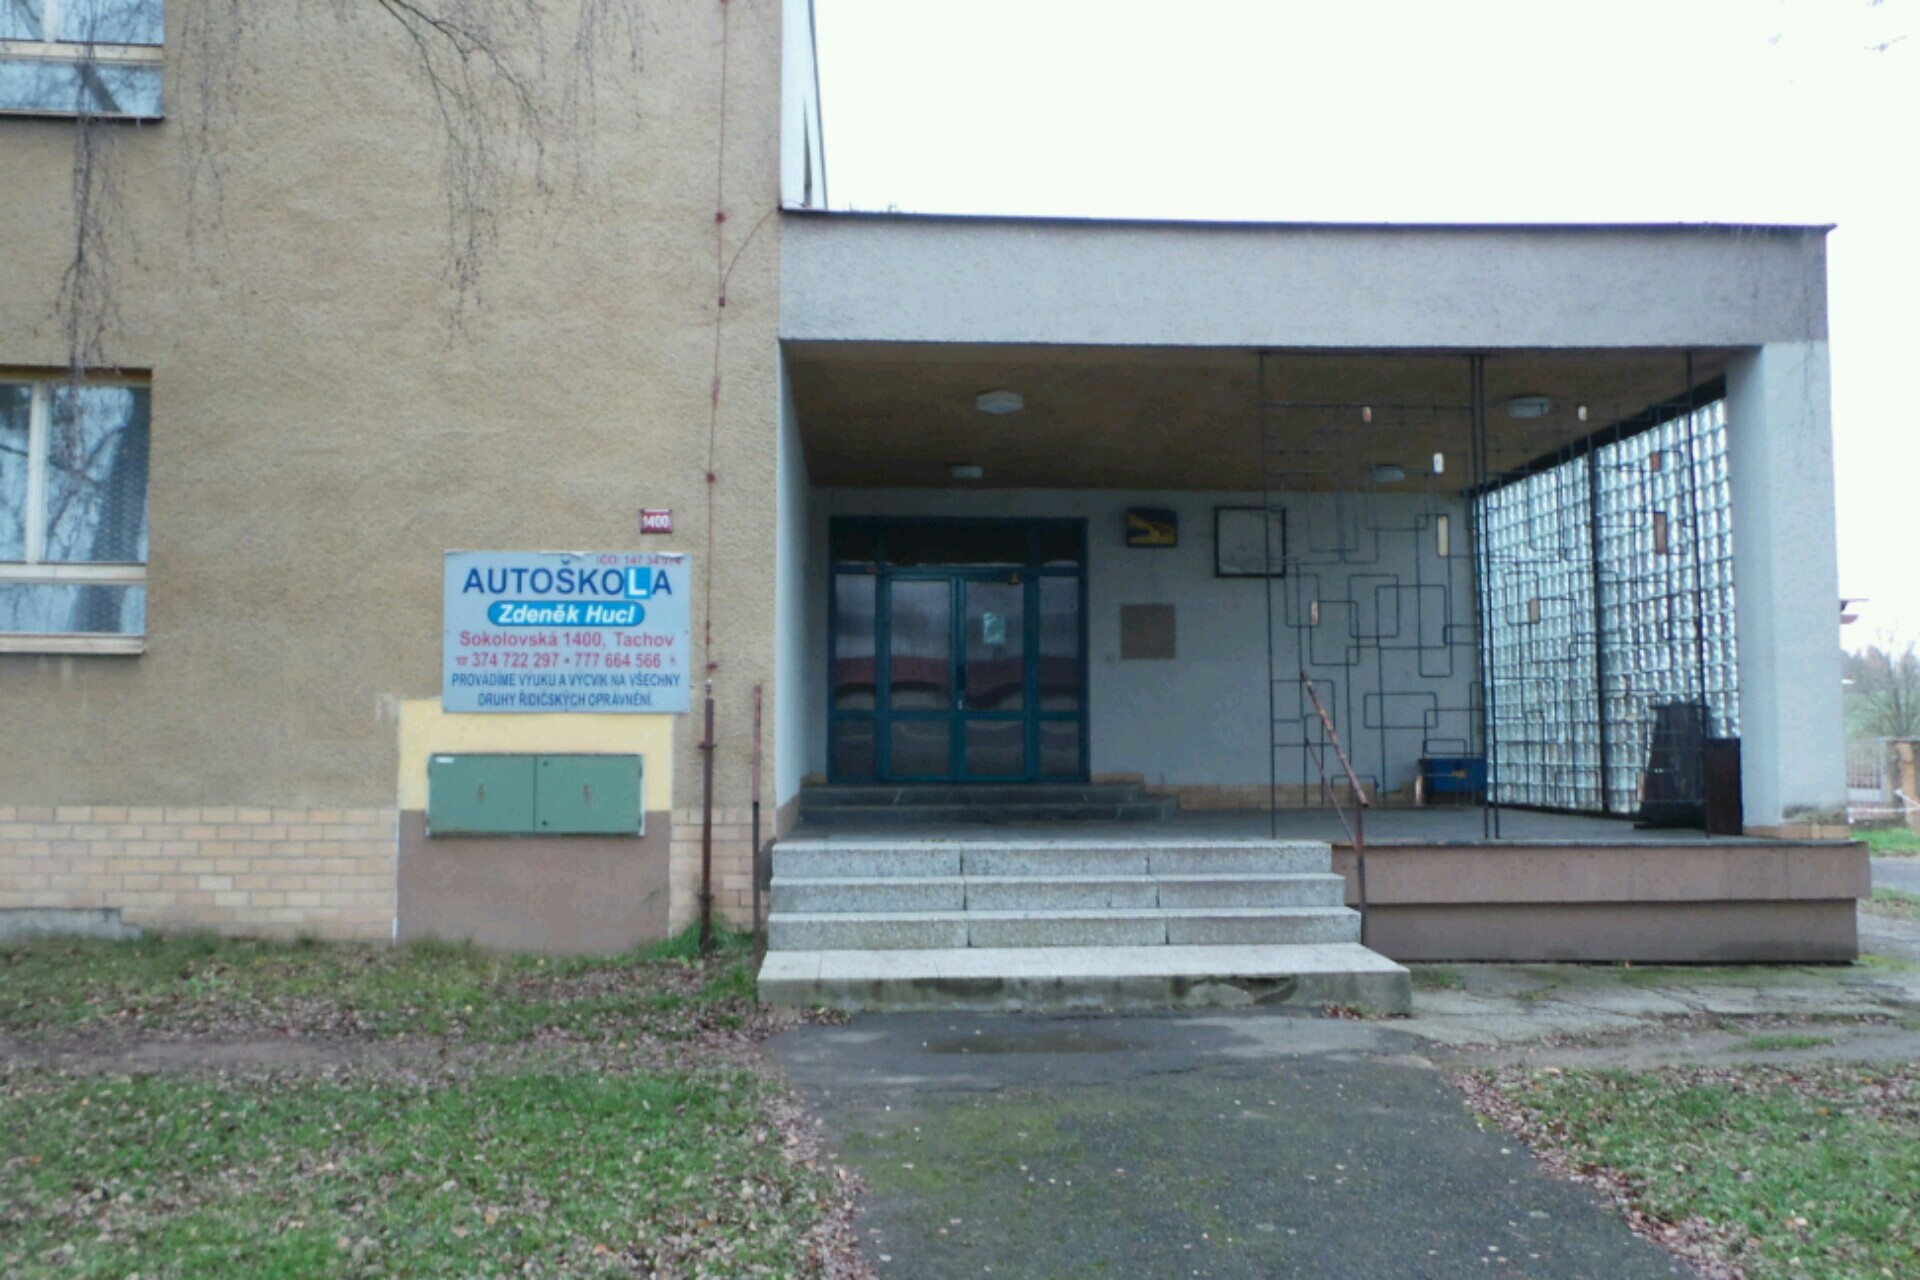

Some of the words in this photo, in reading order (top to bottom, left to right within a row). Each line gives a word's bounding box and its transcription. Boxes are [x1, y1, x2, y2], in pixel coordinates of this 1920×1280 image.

[643, 515, 669, 529] 1400
[462, 559, 673, 596] AUTOŠKOLA
[498, 604, 580, 624] Zdeněk
[586, 604, 636, 624] Hucl
[459, 630, 558, 647] Sokolovská
[564, 631, 607, 649] 1400,
[615, 632, 675, 648] Tachov
[472, 652, 498, 668] 374
[503, 652, 529, 668] 722
[533, 652, 560, 668] 297
[575, 652, 600, 668] 777
[605, 652, 631, 668] 664
[636, 652, 661, 668] 566
[451, 671, 516, 686] PROVÁDÍME
[519, 671, 556, 686] VÝUKU
[558, 673, 566, 686] A
[569, 671, 608, 686] VÝCVIK
[610, 673, 626, 686] NA
[629, 671, 681, 687] VŠECHNY
[478, 692, 516, 706] DRUHY
[519, 690, 584, 707] ŘIDIČSKÝCH
